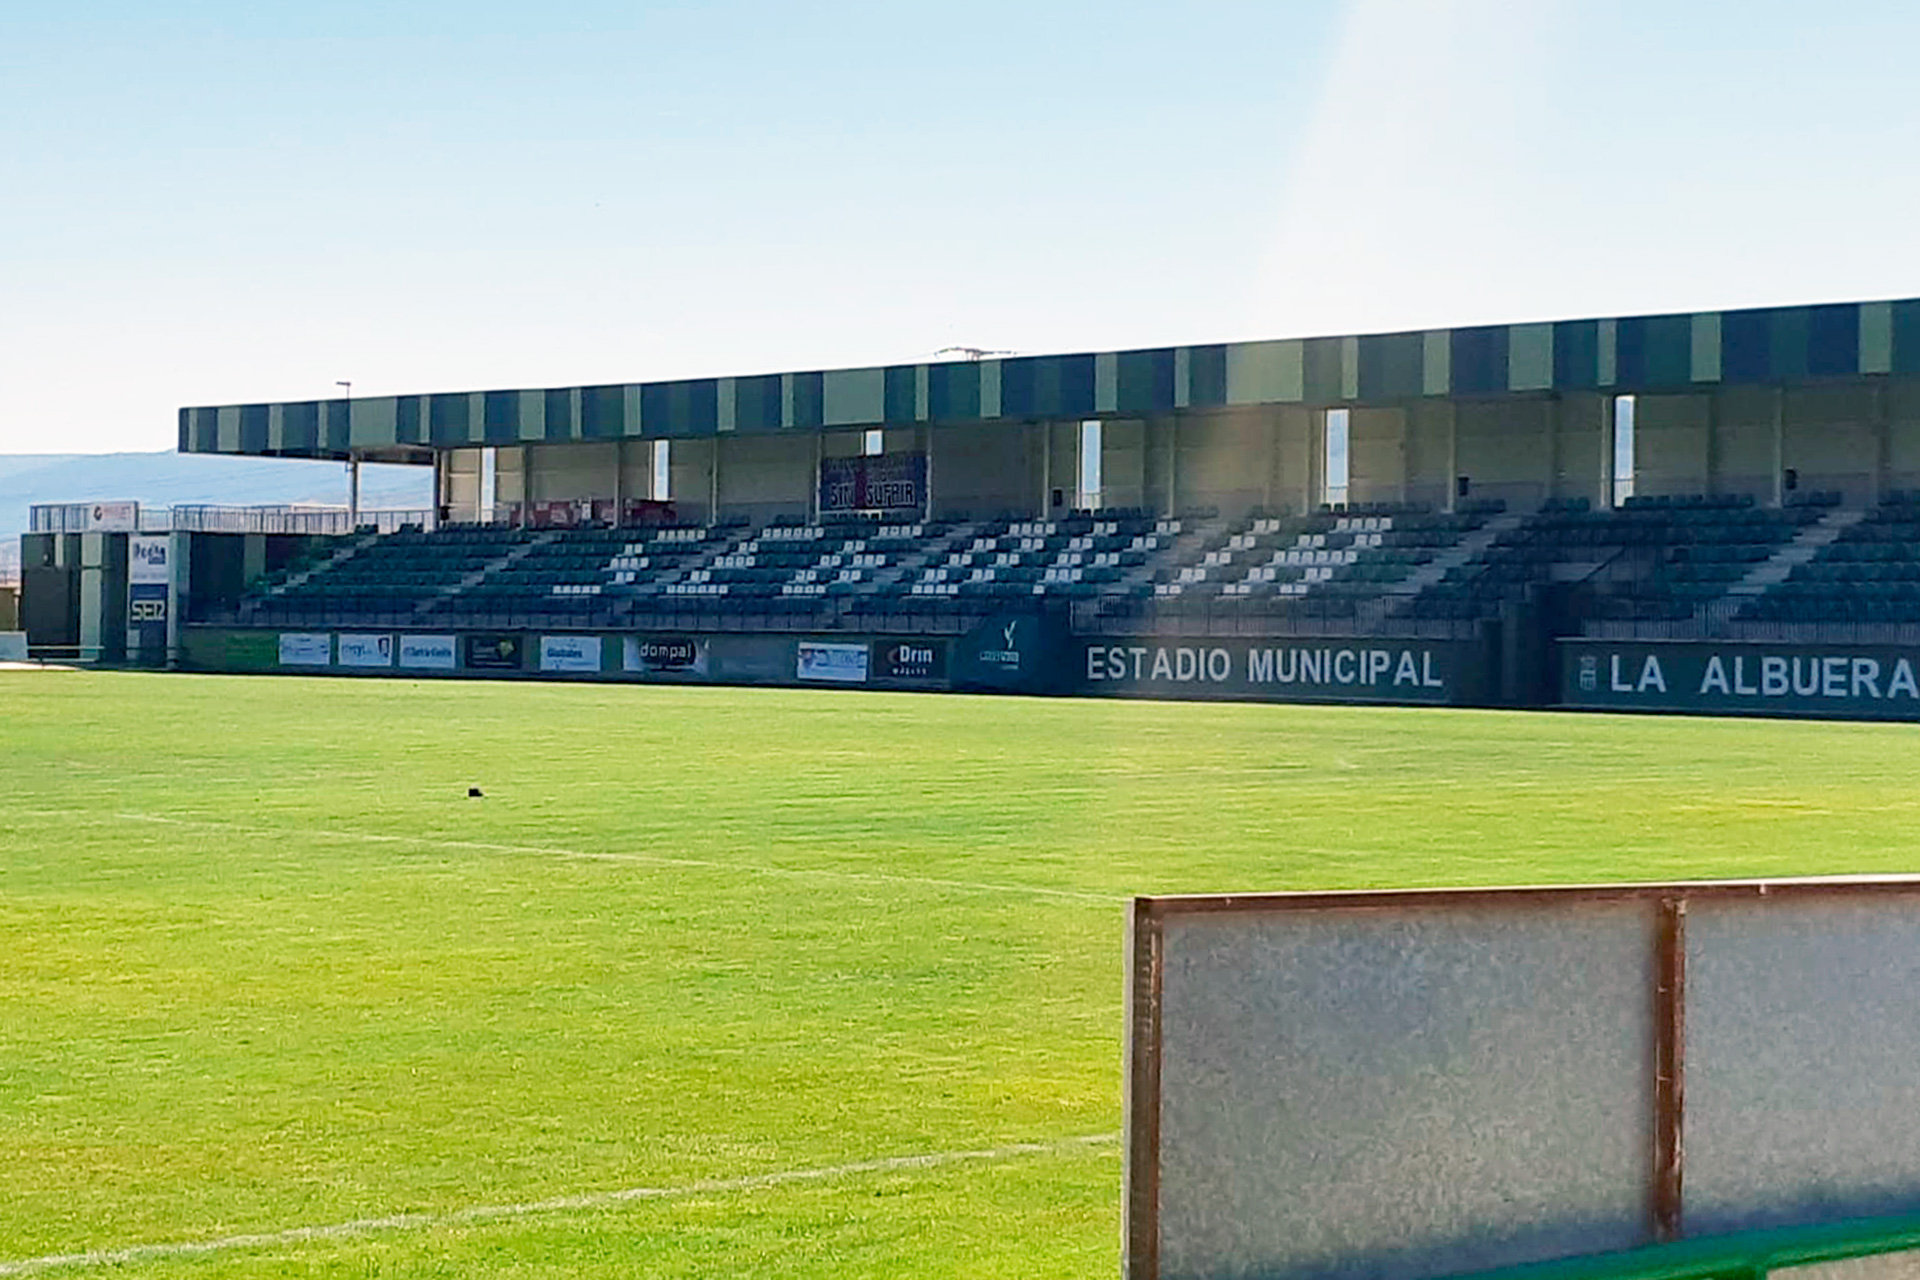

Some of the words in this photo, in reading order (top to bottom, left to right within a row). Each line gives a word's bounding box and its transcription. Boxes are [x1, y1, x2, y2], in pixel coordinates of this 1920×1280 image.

[1086, 646, 1231, 682] ESTADIO
[1247, 648, 1443, 687] MUNICIPAL
[1611, 655, 1667, 693] LA
[1700, 655, 1920, 699] ALBUERA
